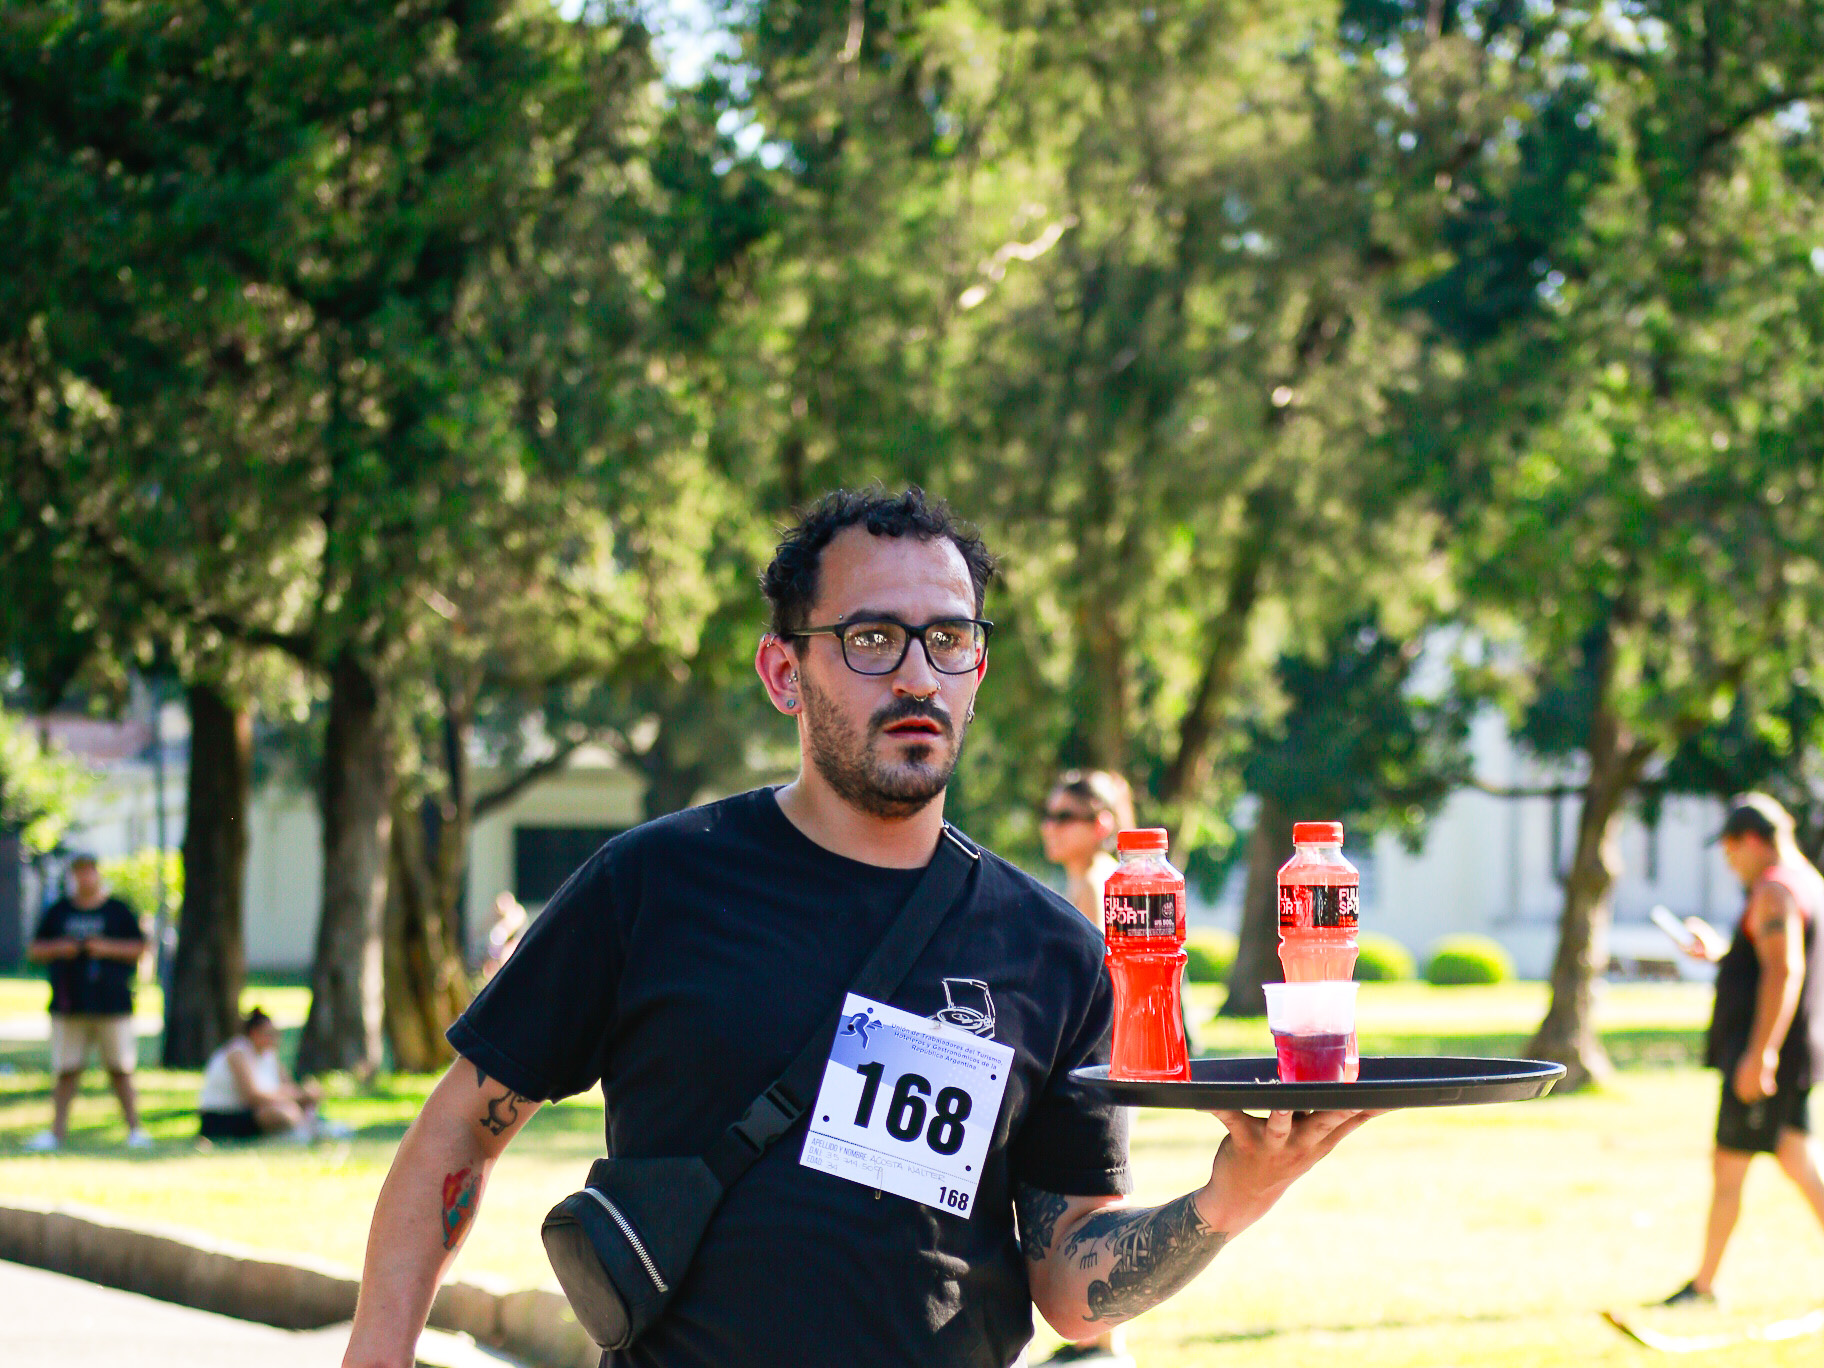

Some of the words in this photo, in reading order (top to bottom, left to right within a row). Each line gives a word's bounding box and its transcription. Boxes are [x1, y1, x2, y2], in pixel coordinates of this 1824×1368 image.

[1105, 897, 1133, 911] FULL
[1105, 910, 1147, 924] SPORT
[894, 1032, 925, 1046] Hoteleros
[933, 1044, 980, 1064] Gastronómicos
[922, 1033, 963, 1051] Trabajadores
[965, 1047, 975, 1055] del
[911, 1044, 944, 1060] República
[945, 1055, 977, 1071] Argentina
[854, 1061, 973, 1156] 168
[939, 1186, 970, 1211] 168
